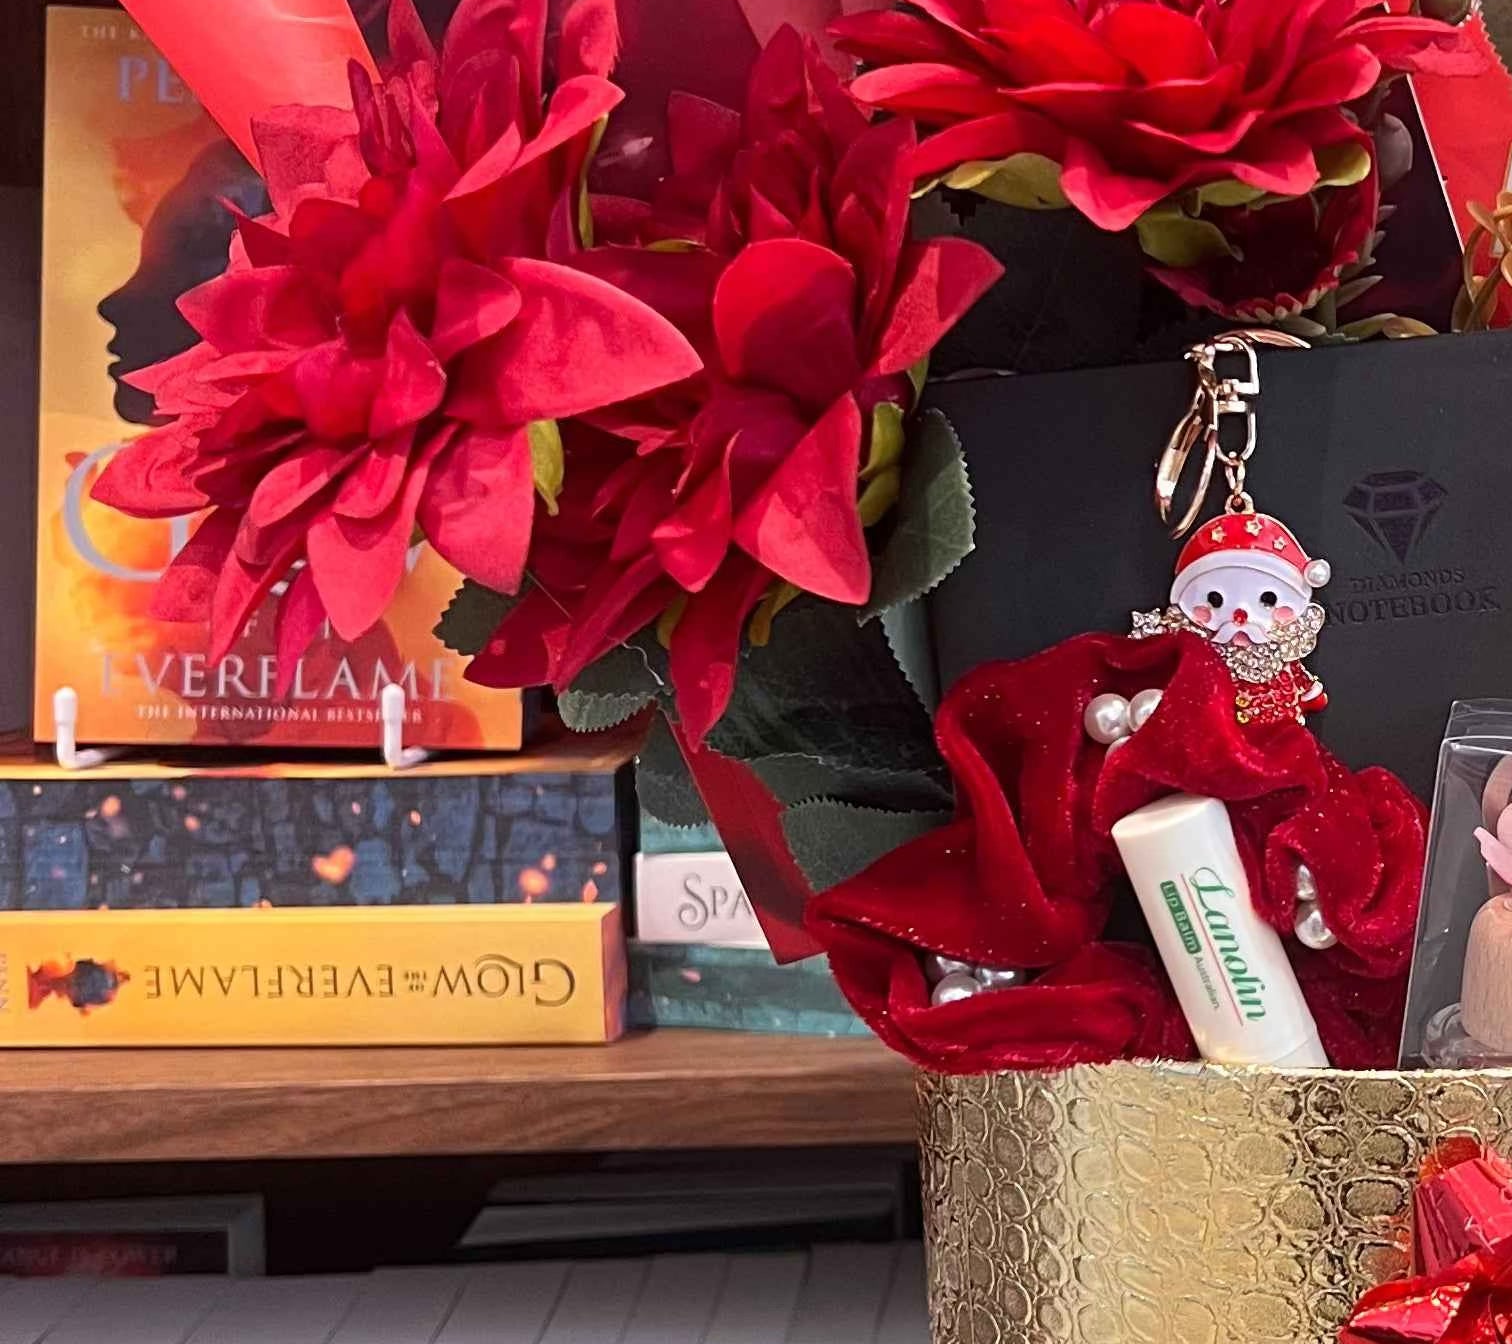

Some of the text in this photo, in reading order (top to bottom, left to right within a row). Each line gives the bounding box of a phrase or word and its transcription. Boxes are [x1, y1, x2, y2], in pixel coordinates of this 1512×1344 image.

[1327, 585, 1502, 627] NOTEBOOK
[1170, 910, 1201, 954] Balm
[1188, 865, 1271, 1023] Lanolin
[144, 964, 394, 1000] EVERFLAME
